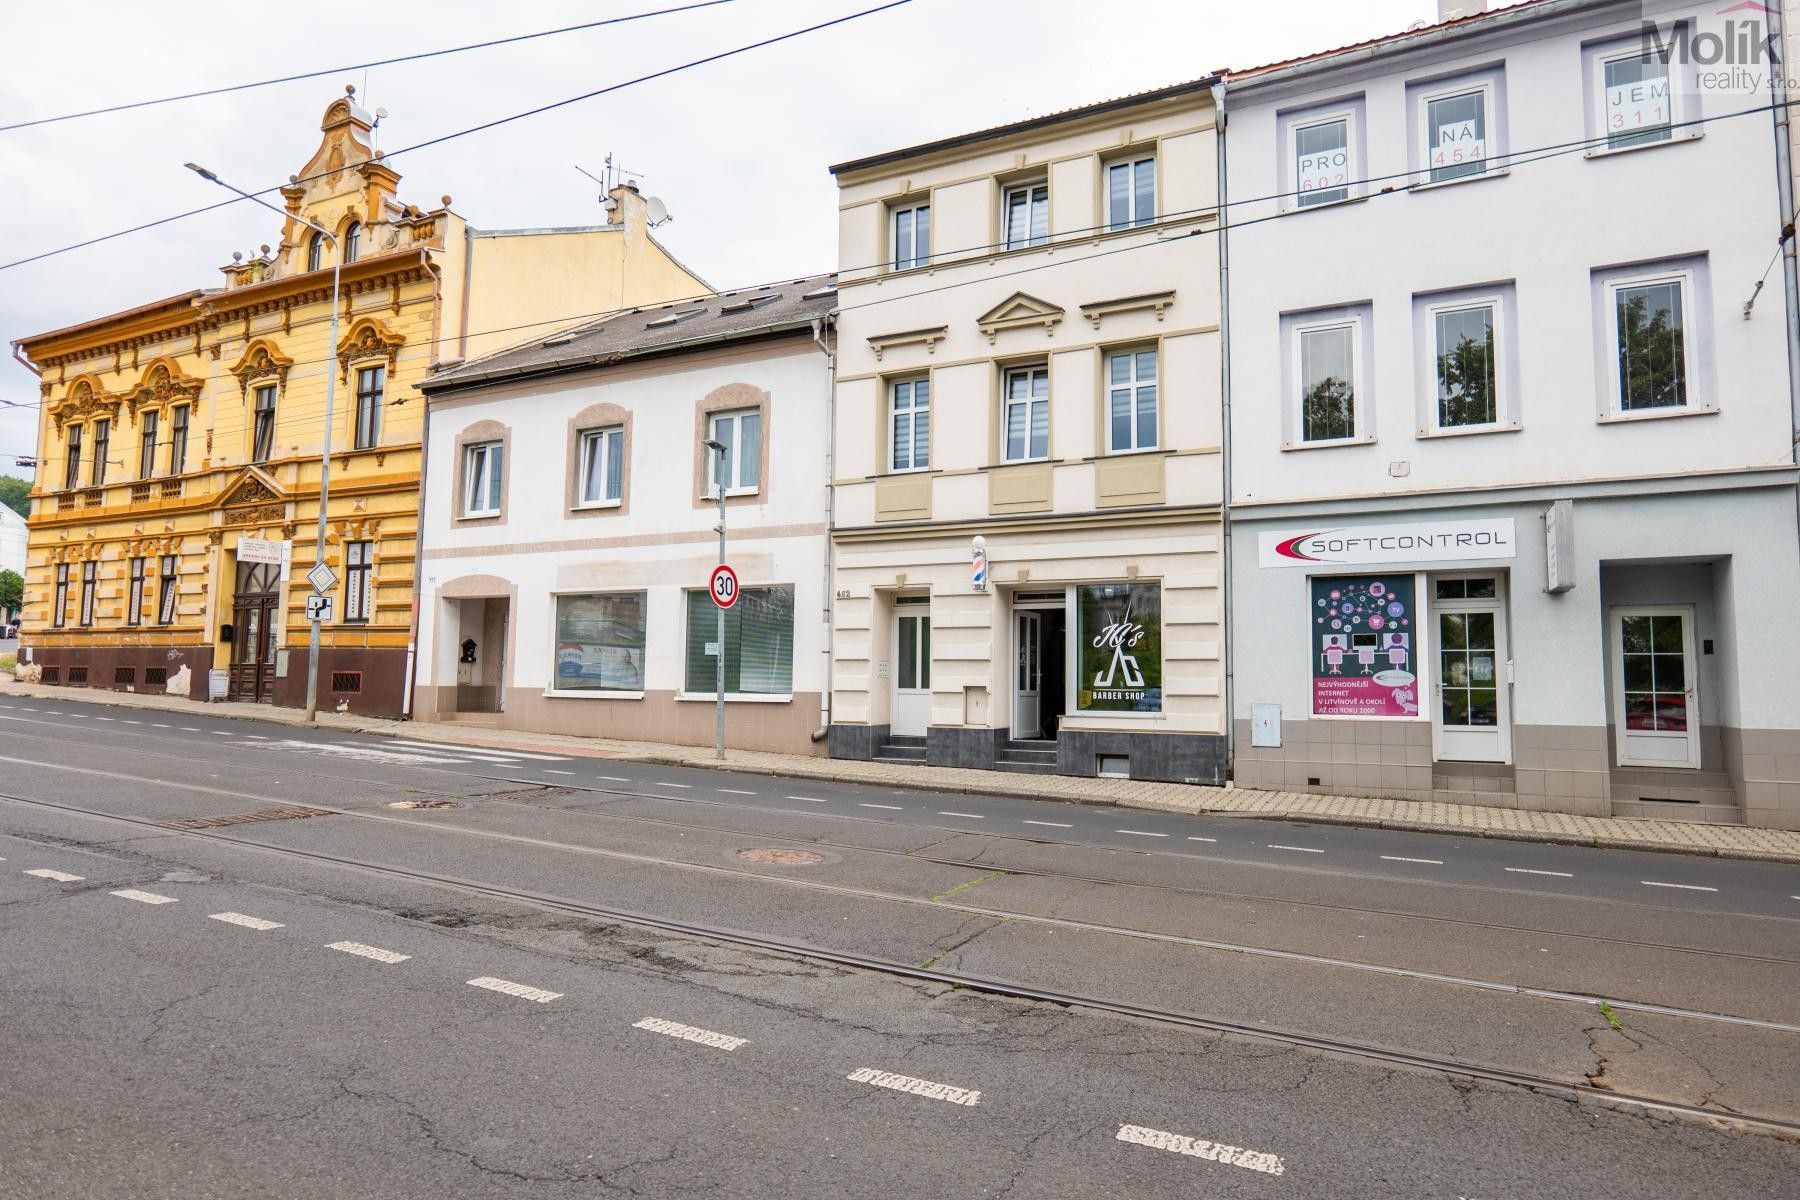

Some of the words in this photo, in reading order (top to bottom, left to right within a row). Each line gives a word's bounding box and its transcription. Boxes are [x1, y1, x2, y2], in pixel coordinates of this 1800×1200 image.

[1612, 83, 1668, 106] JEM
[1613, 106, 1662, 128] 311
[1443, 123, 1473, 144] NÁ
[1302, 153, 1346, 173] PRO
[1434, 145, 1480, 165] 454
[1303, 173, 1344, 191] 602
[1311, 531, 1507, 553] SOFTCONTROL
[716, 576, 733, 596] 30
[1092, 691, 1122, 700] BARBER
[1125, 691, 1145, 700] SHOP
